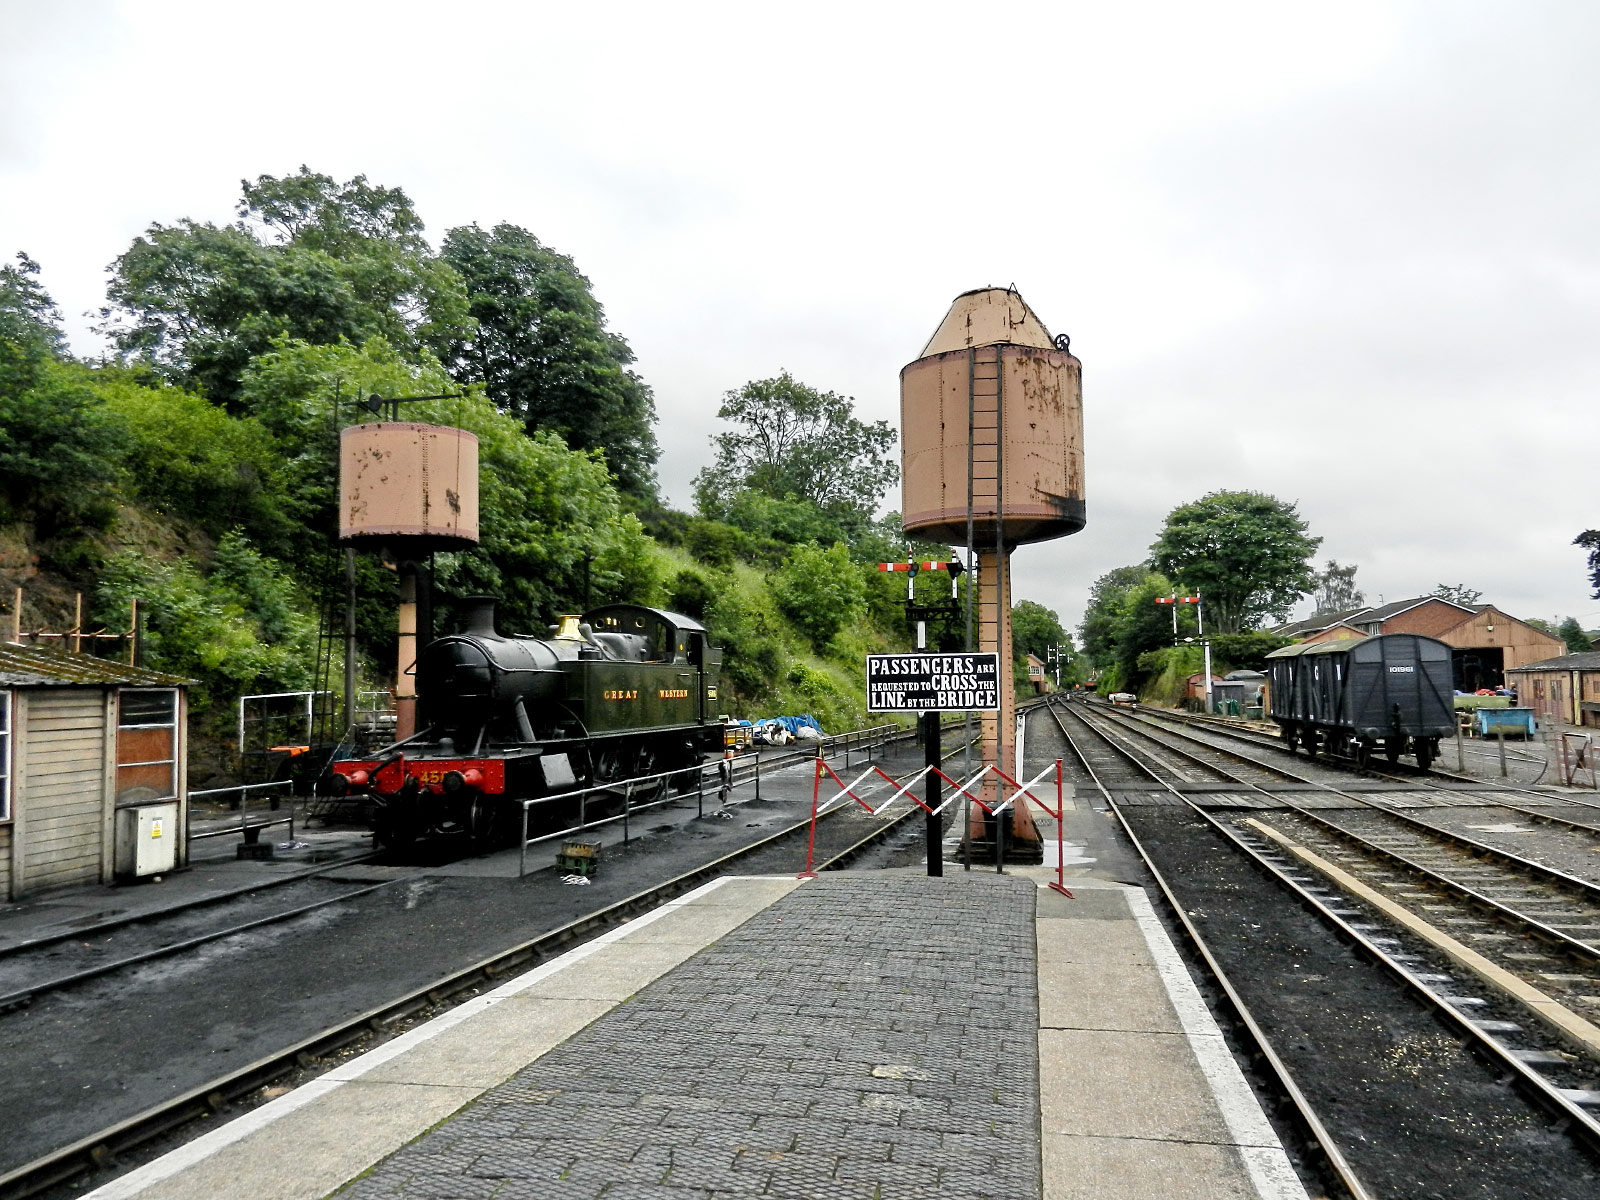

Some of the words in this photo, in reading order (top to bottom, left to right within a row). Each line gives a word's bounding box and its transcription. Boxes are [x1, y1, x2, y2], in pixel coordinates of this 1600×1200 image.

[871, 658, 973, 675] PASSENGERS
[977, 664, 995, 673] ARE
[871, 682, 920, 692] REQUESTED
[920, 682, 931, 691] TO
[931, 674, 978, 691] CROSS
[978, 680, 995, 690] THE
[604, 690, 638, 699] GREAT
[660, 689, 688, 698] WESTERN
[871, 691, 906, 708] LINE
[907, 699, 918, 708] BY
[919, 698, 936, 708] THE
[937, 690, 996, 707] BRIDGE
